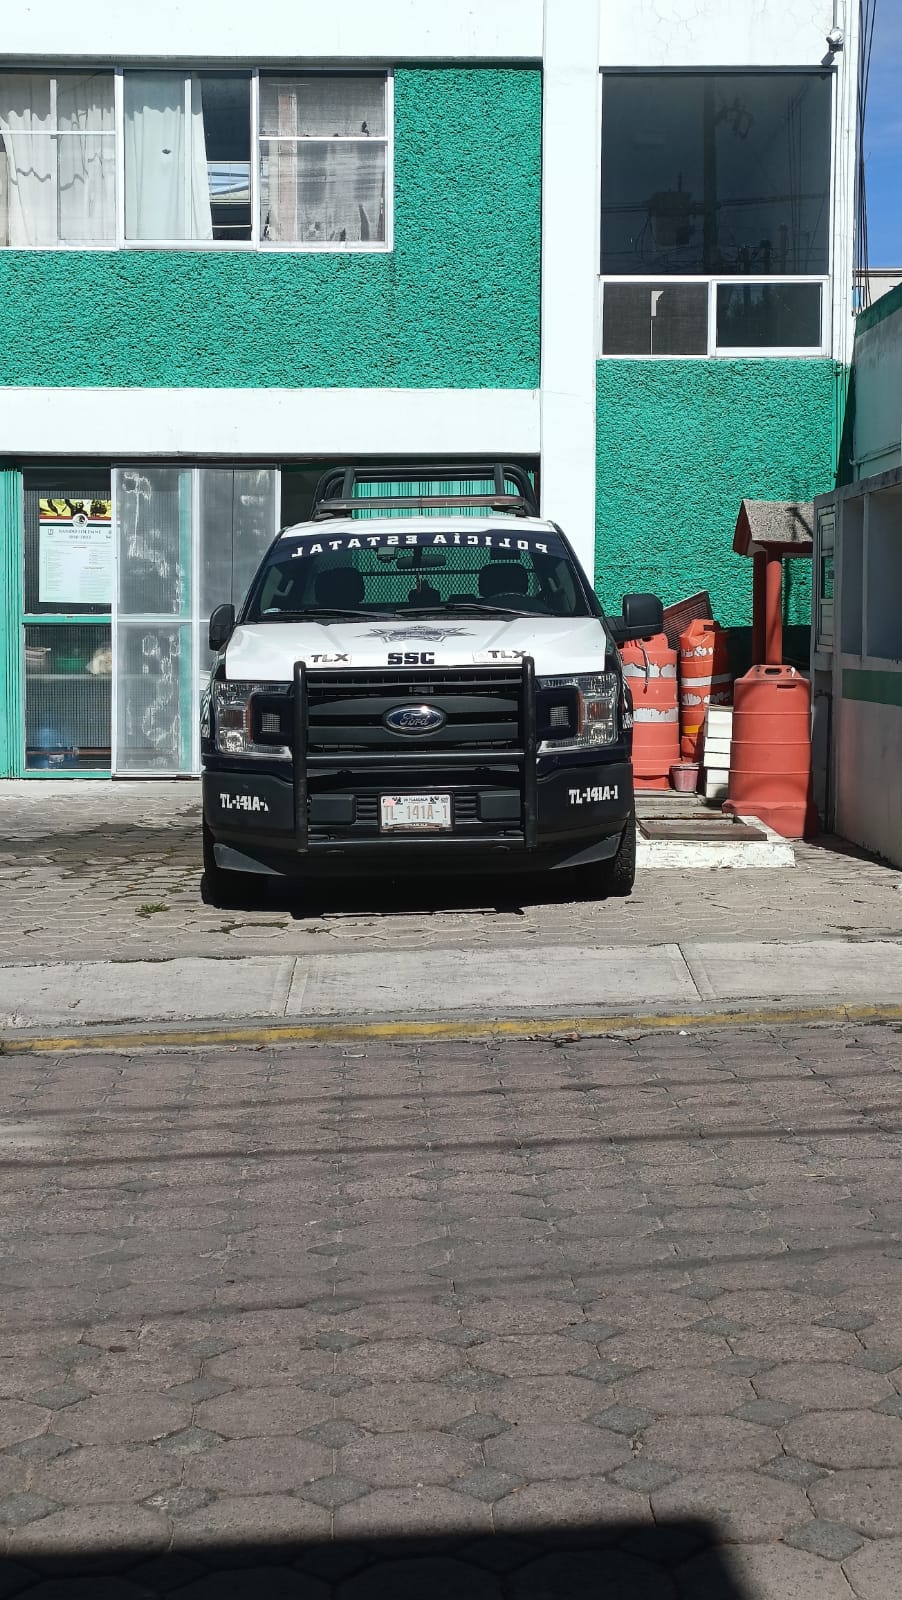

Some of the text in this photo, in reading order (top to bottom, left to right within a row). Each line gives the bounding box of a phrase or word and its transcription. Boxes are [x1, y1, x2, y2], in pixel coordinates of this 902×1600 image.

[310, 653, 349, 663] TLX
[387, 652, 435, 665] SSC
[487, 650, 528, 659] TLX
[399, 711, 430, 727] Ford
[568, 784, 619, 804] TL-141A-1
